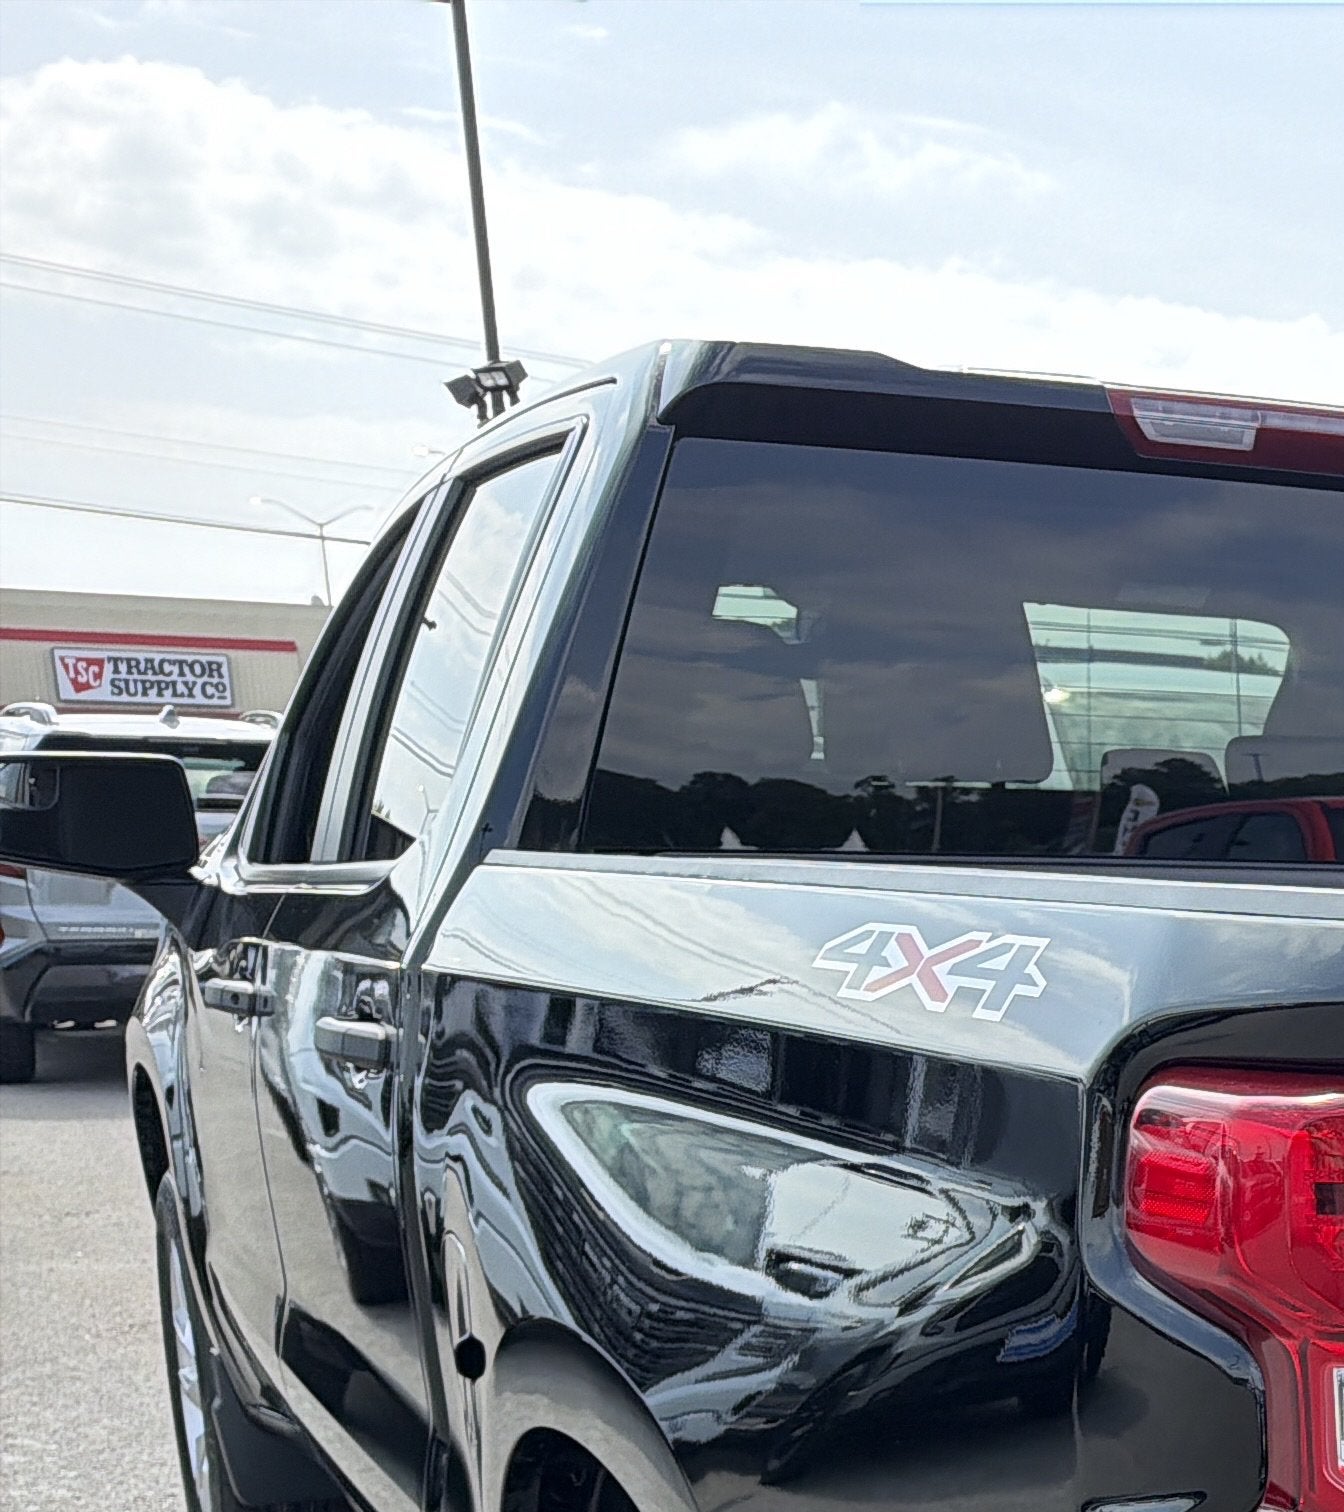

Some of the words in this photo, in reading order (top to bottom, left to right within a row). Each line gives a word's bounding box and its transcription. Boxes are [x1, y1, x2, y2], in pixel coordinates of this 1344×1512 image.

[64, 656, 100, 687] TSC
[107, 655, 224, 679] TRACTOR
[110, 678, 197, 698] SUPPLY
